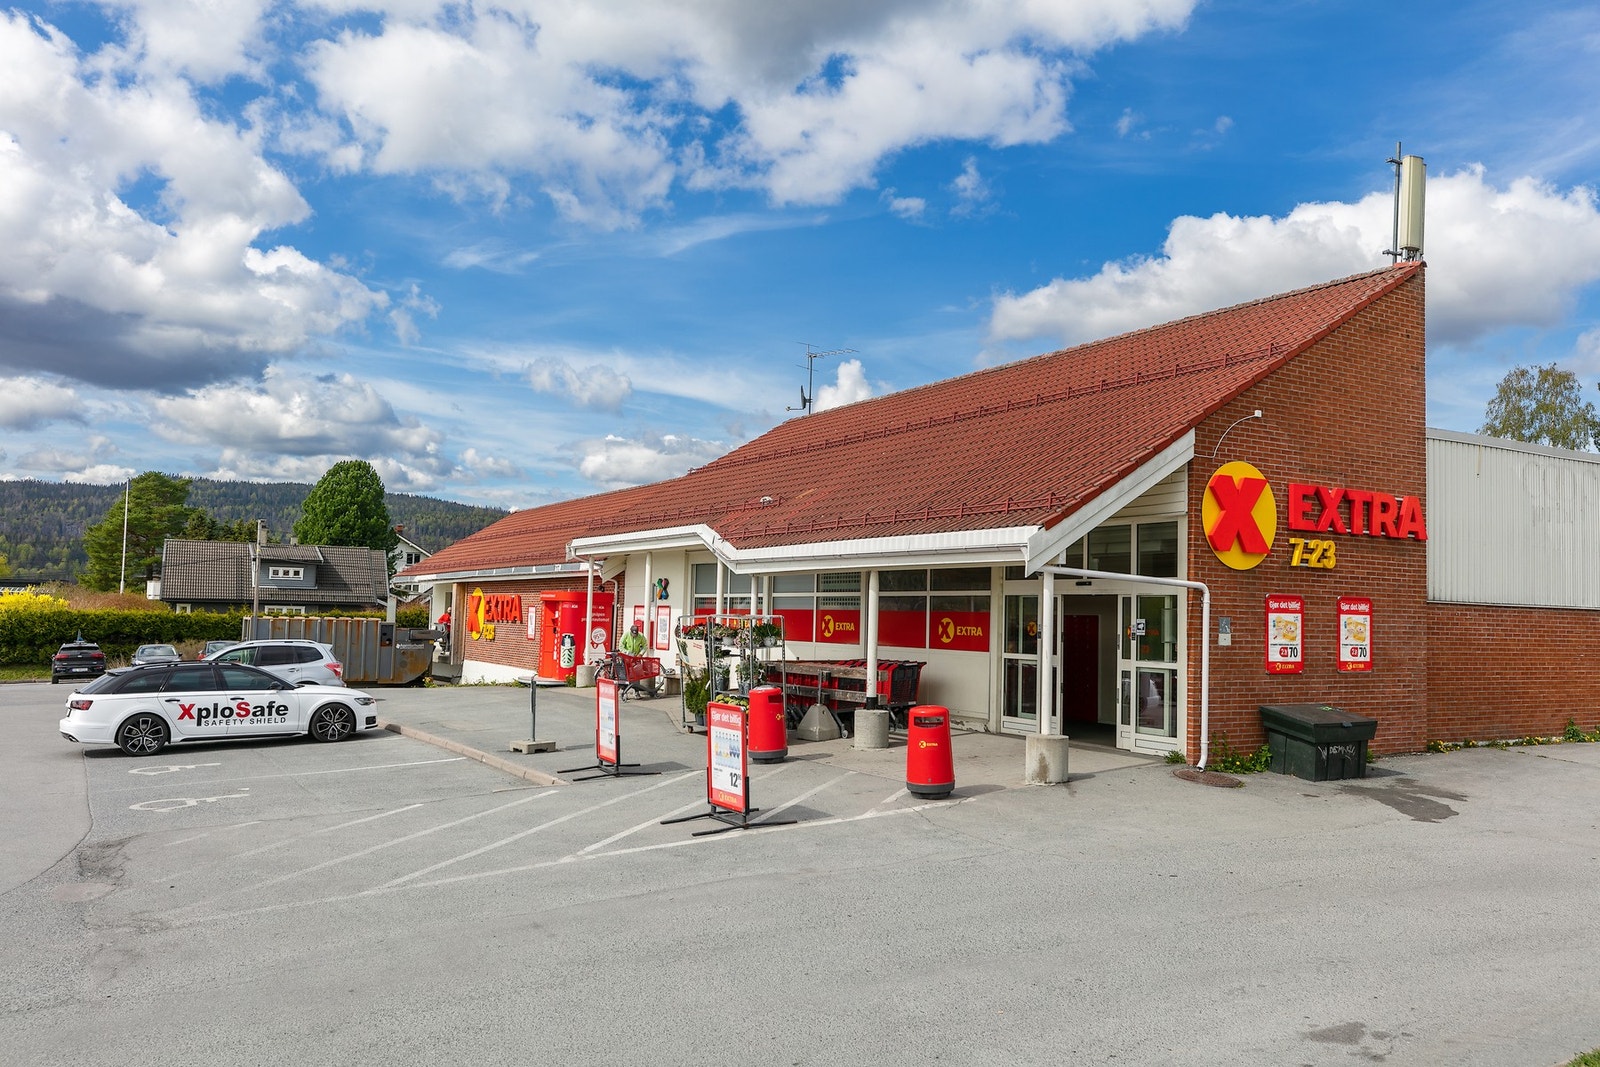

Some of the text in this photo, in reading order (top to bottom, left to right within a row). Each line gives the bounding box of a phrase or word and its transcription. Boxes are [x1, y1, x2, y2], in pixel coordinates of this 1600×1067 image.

[1208, 474, 1428, 555] X EXTRA
[1289, 538, 1337, 569] 7-23
[484, 594, 522, 623] EXTRA
[1280, 601, 1288, 609] det
[1350, 603, 1358, 611] det
[835, 622, 855, 631] EXTRA
[956, 626, 983, 637] EXTRA
[1289, 647, 1298, 657] 70
[1359, 647, 1367, 658] 70
[177, 700, 289, 727] XploSafe
[204, 717, 287, 727] SAFETY SHIELD
[730, 772, 738, 788] 12
